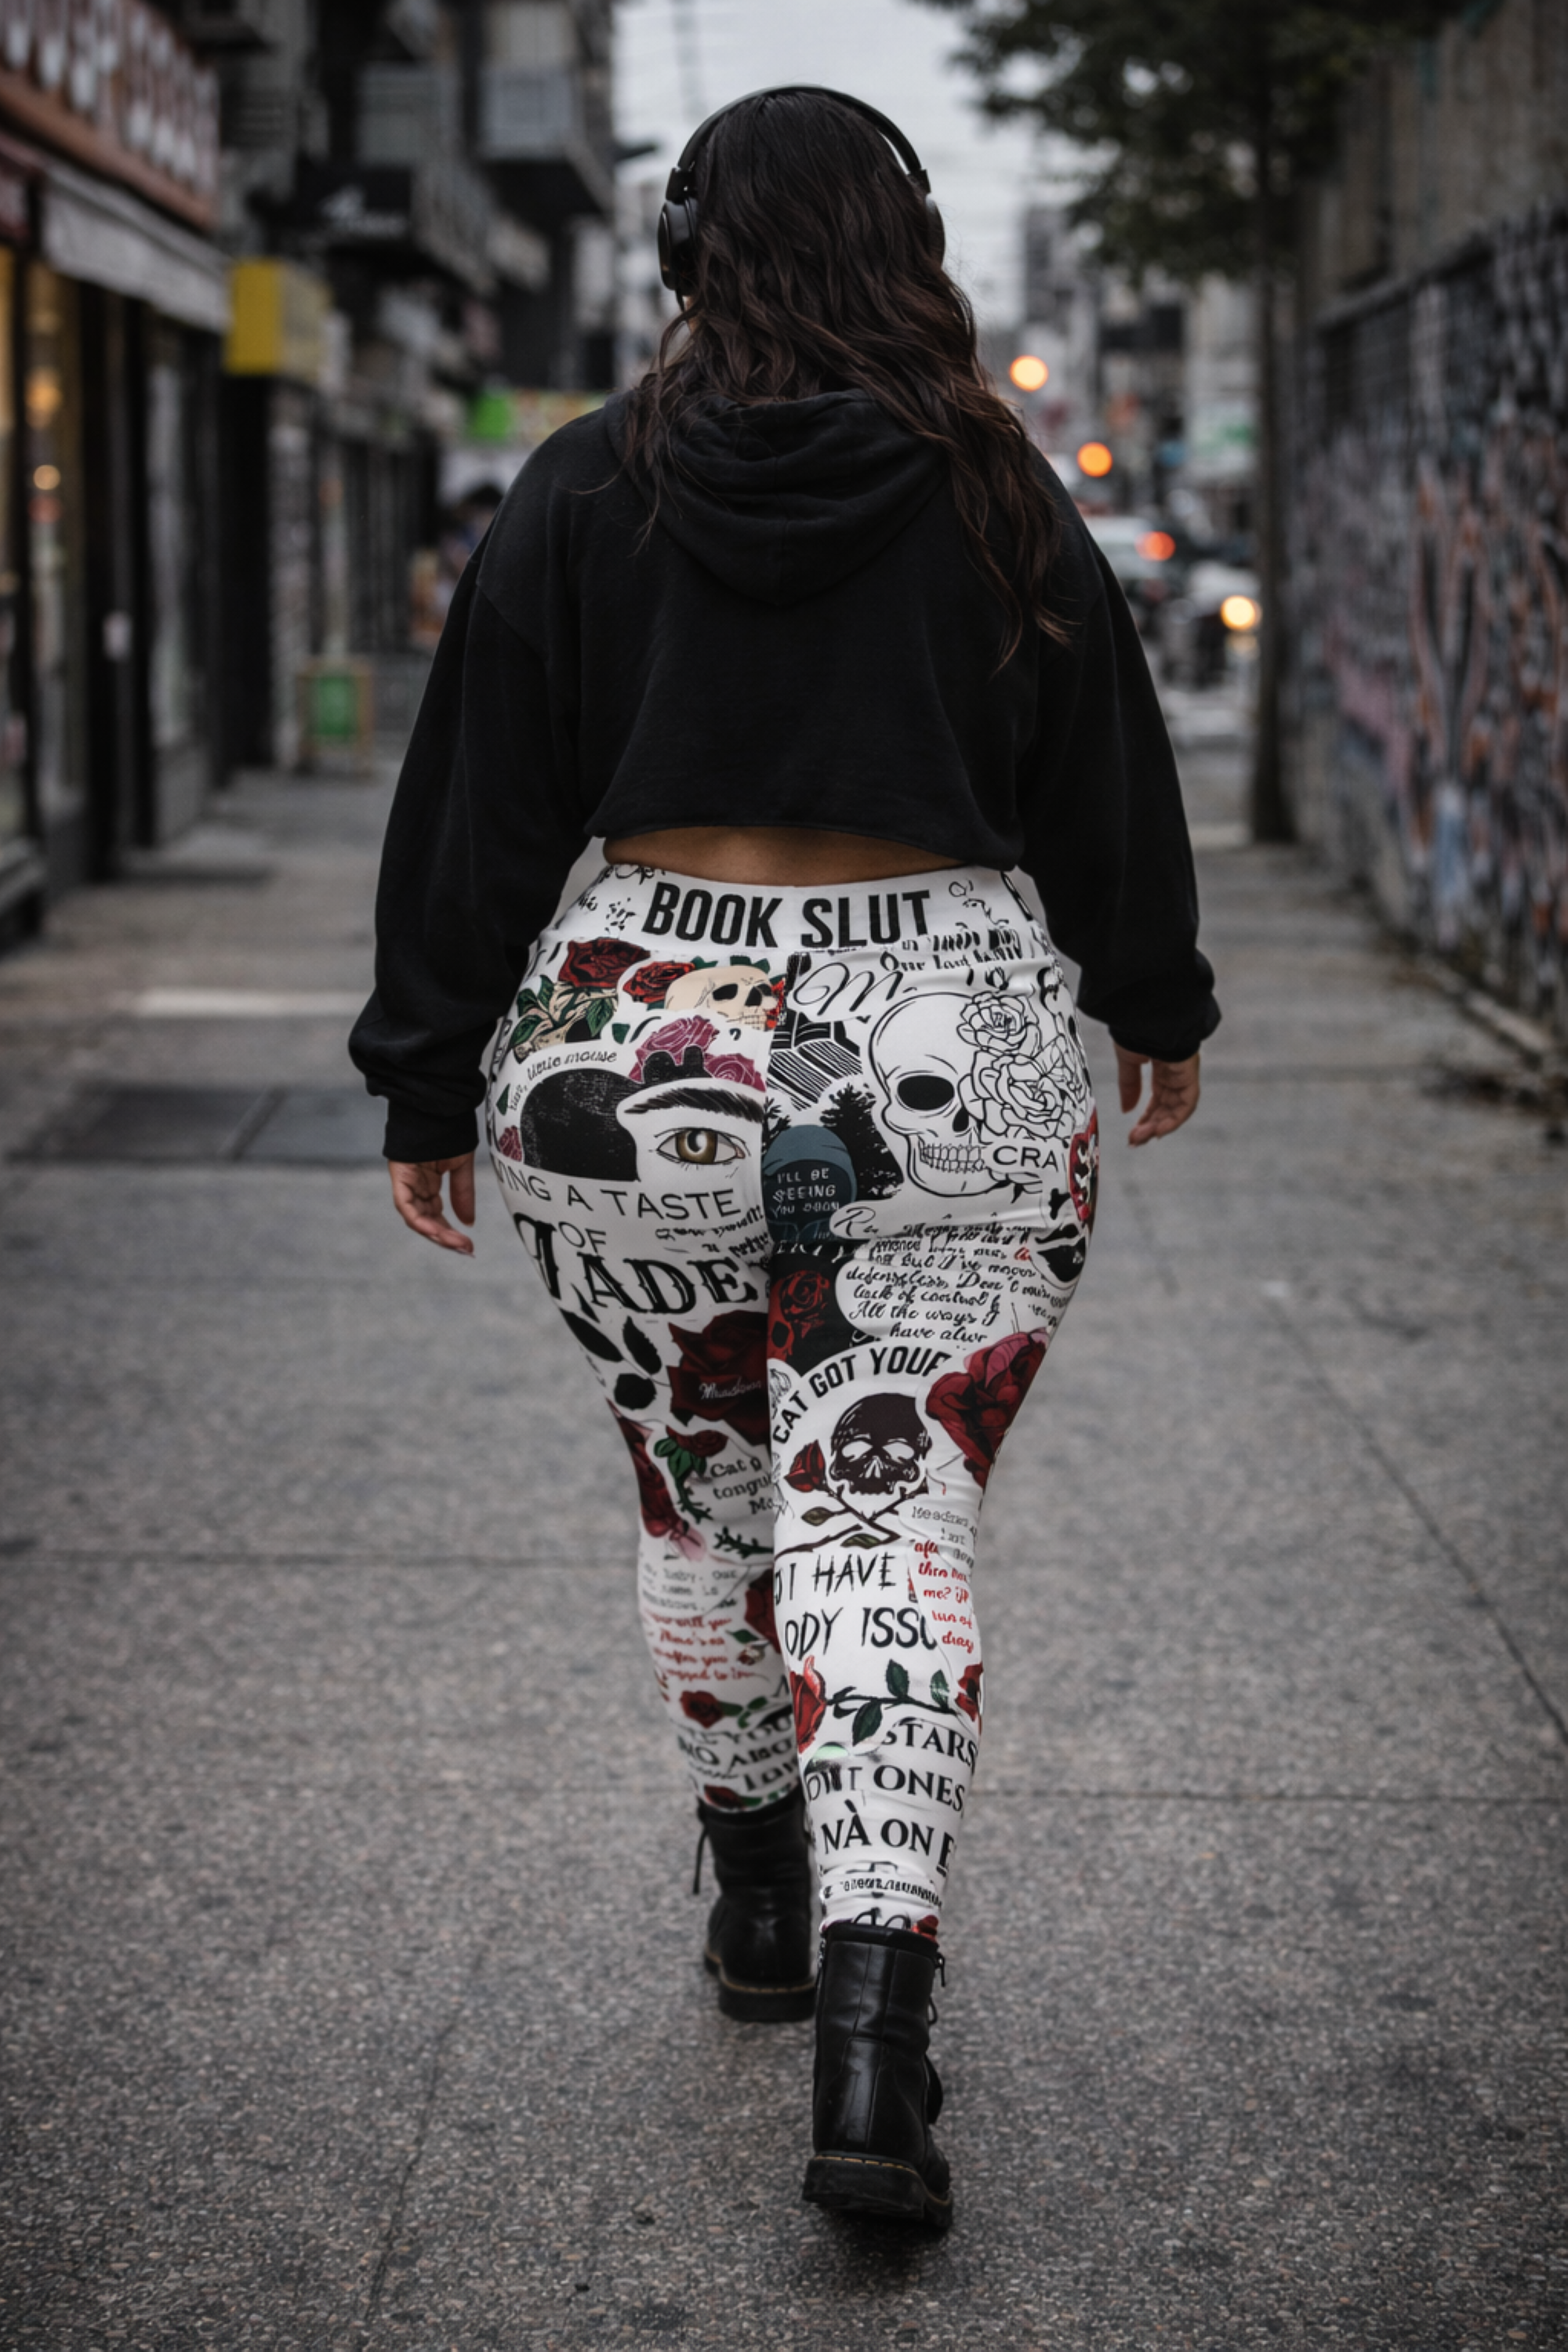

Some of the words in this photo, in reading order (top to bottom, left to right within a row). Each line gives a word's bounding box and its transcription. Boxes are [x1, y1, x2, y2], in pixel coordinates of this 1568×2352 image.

[642, 881, 783, 949] BOOK
[800, 890, 931, 949] SLUT
[993, 1145, 1059, 1174] CRA
[567, 1185, 594, 1212] A
[600, 1189, 742, 1221] TASTE
[558, 1221, 607, 1254] OF
[772, 1390, 809, 1444] CAT
[808, 1354, 857, 1399] GOT
[811, 1552, 897, 1597] HAVE
[873, 1764, 966, 1813] ONES
